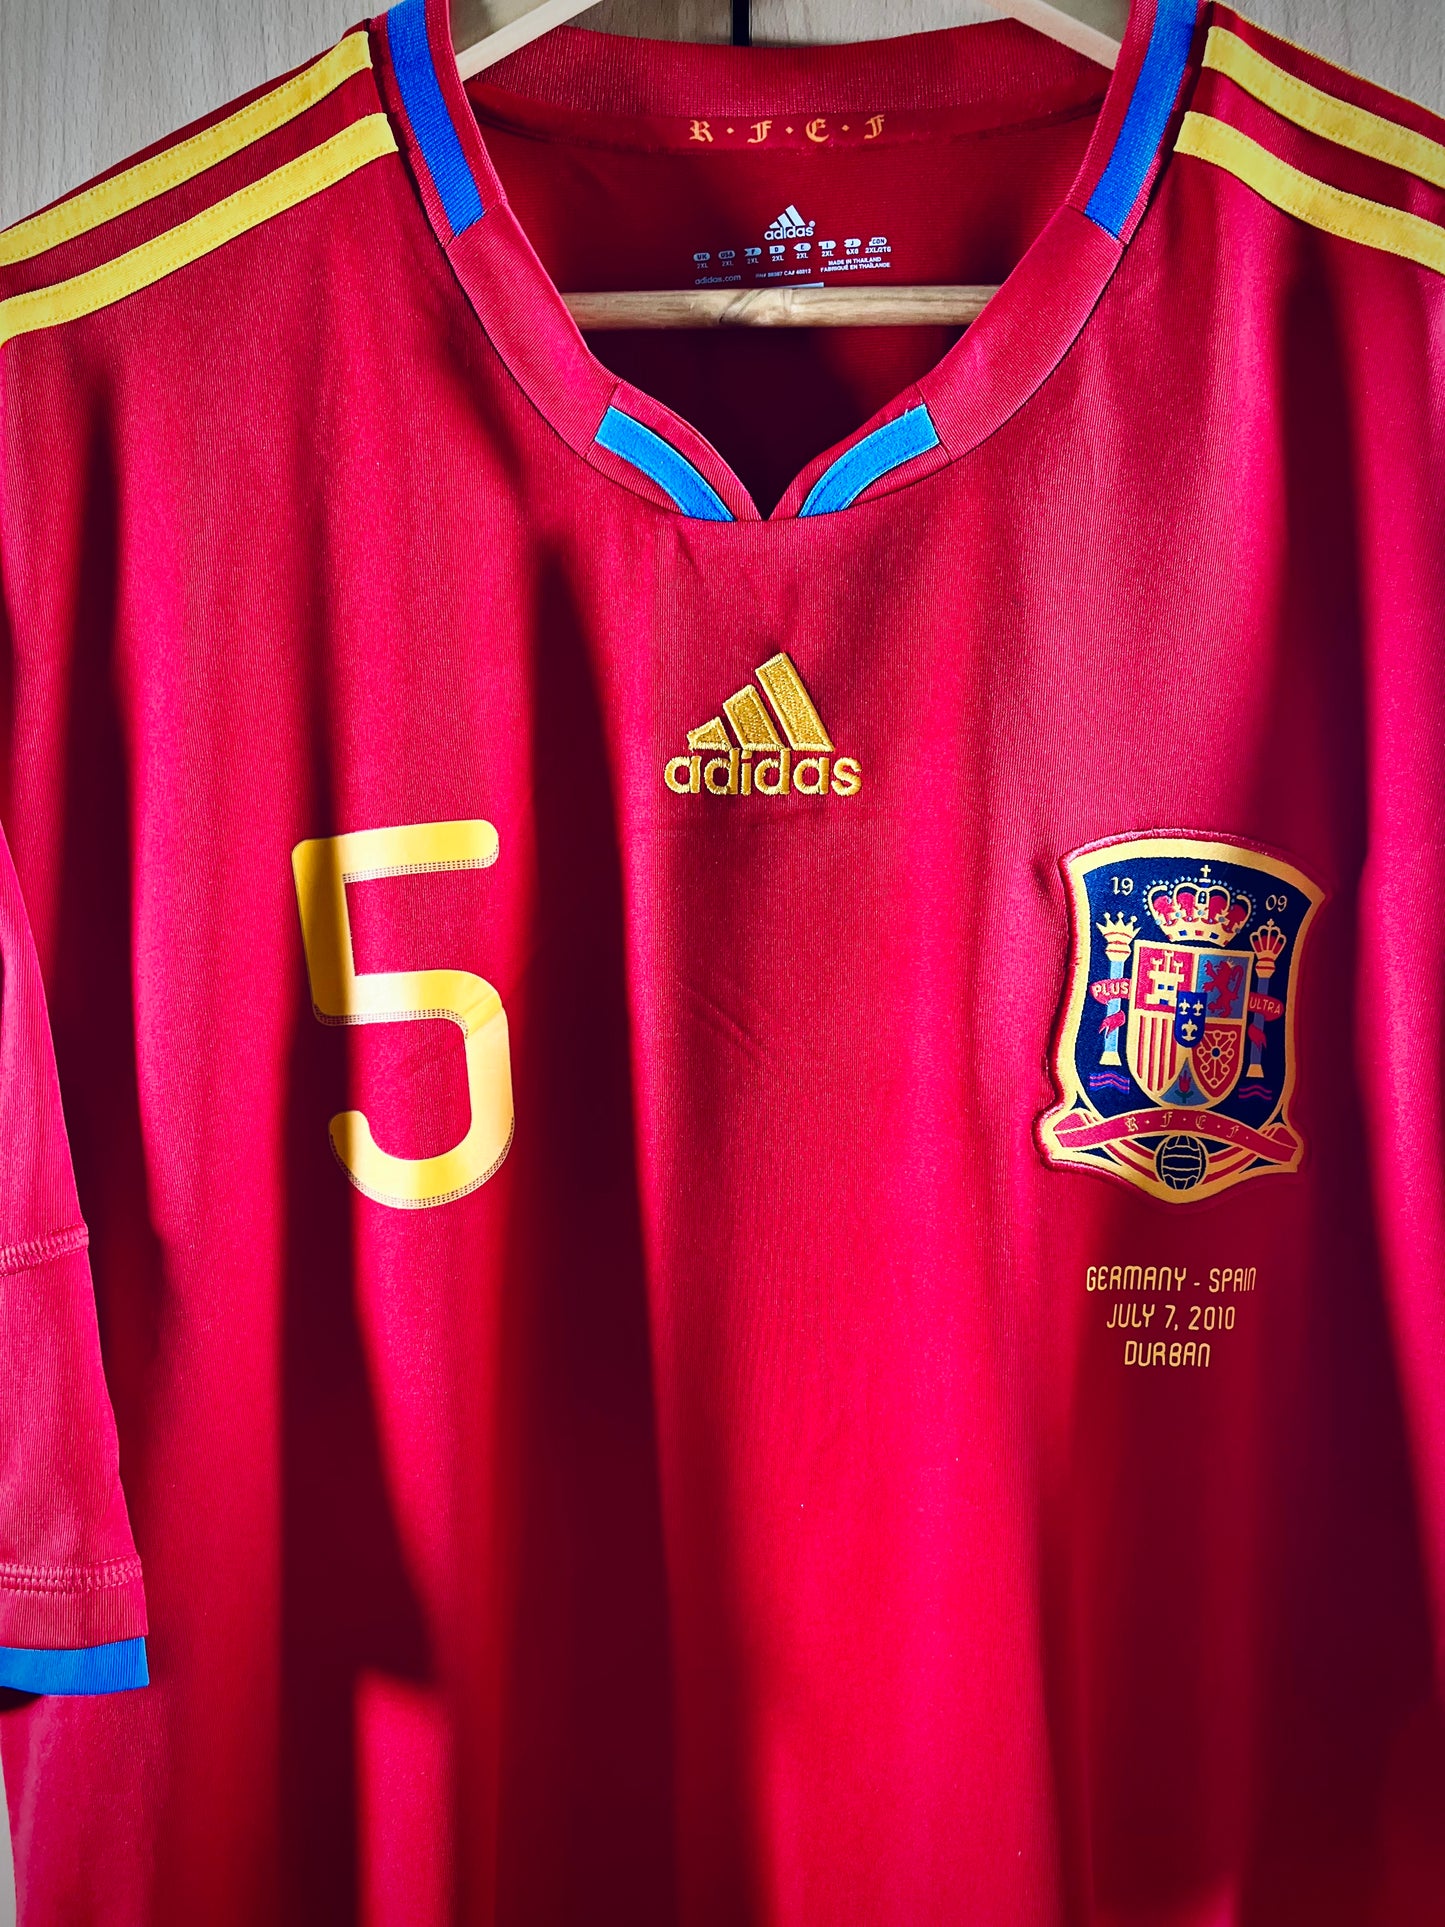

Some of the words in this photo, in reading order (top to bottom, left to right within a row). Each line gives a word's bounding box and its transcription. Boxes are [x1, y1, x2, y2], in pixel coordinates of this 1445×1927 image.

[764, 225, 814, 240] adidas
[695, 275, 741, 285] adidas.com
[664, 747, 862, 796] adidas
[1110, 876, 1134, 897] 19
[1266, 894, 1288, 912] 09
[1092, 979, 1129, 997] PLUS
[291, 819, 515, 1210] 5
[1250, 996, 1281, 1016] ULTRA
[1086, 1265, 1187, 1292] GERMANY
[1208, 1266, 1257, 1293] SPAIN
[1106, 1303, 1155, 1329] JULY
[1164, 1304, 1179, 1331] 7,
[1188, 1305, 1235, 1331] 2010
[1124, 1340, 1211, 1368] DURBAN
